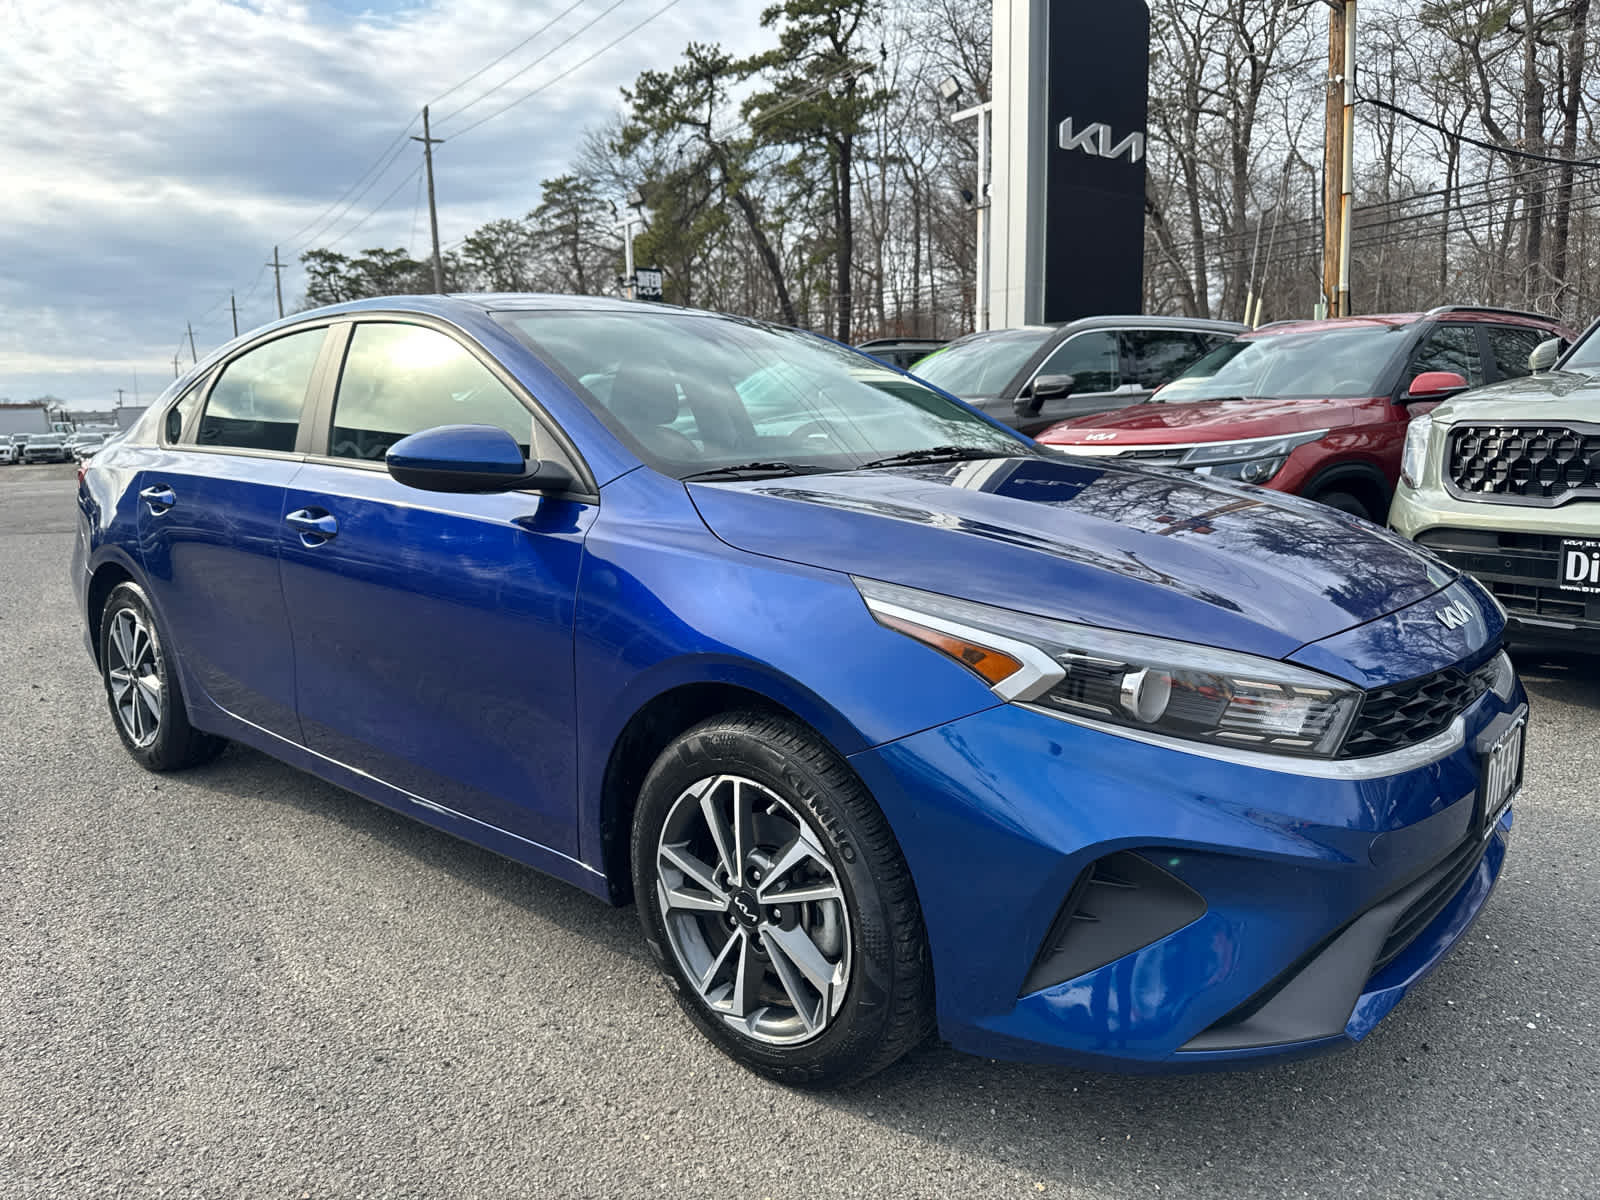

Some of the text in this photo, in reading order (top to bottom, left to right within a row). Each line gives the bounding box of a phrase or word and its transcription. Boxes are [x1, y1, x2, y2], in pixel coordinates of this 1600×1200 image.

[1059, 116, 1144, 163] KIA
[1085, 432, 1117, 441] KIA
[1435, 600, 1473, 629] KIA
[783, 763, 857, 864] KUMHO
